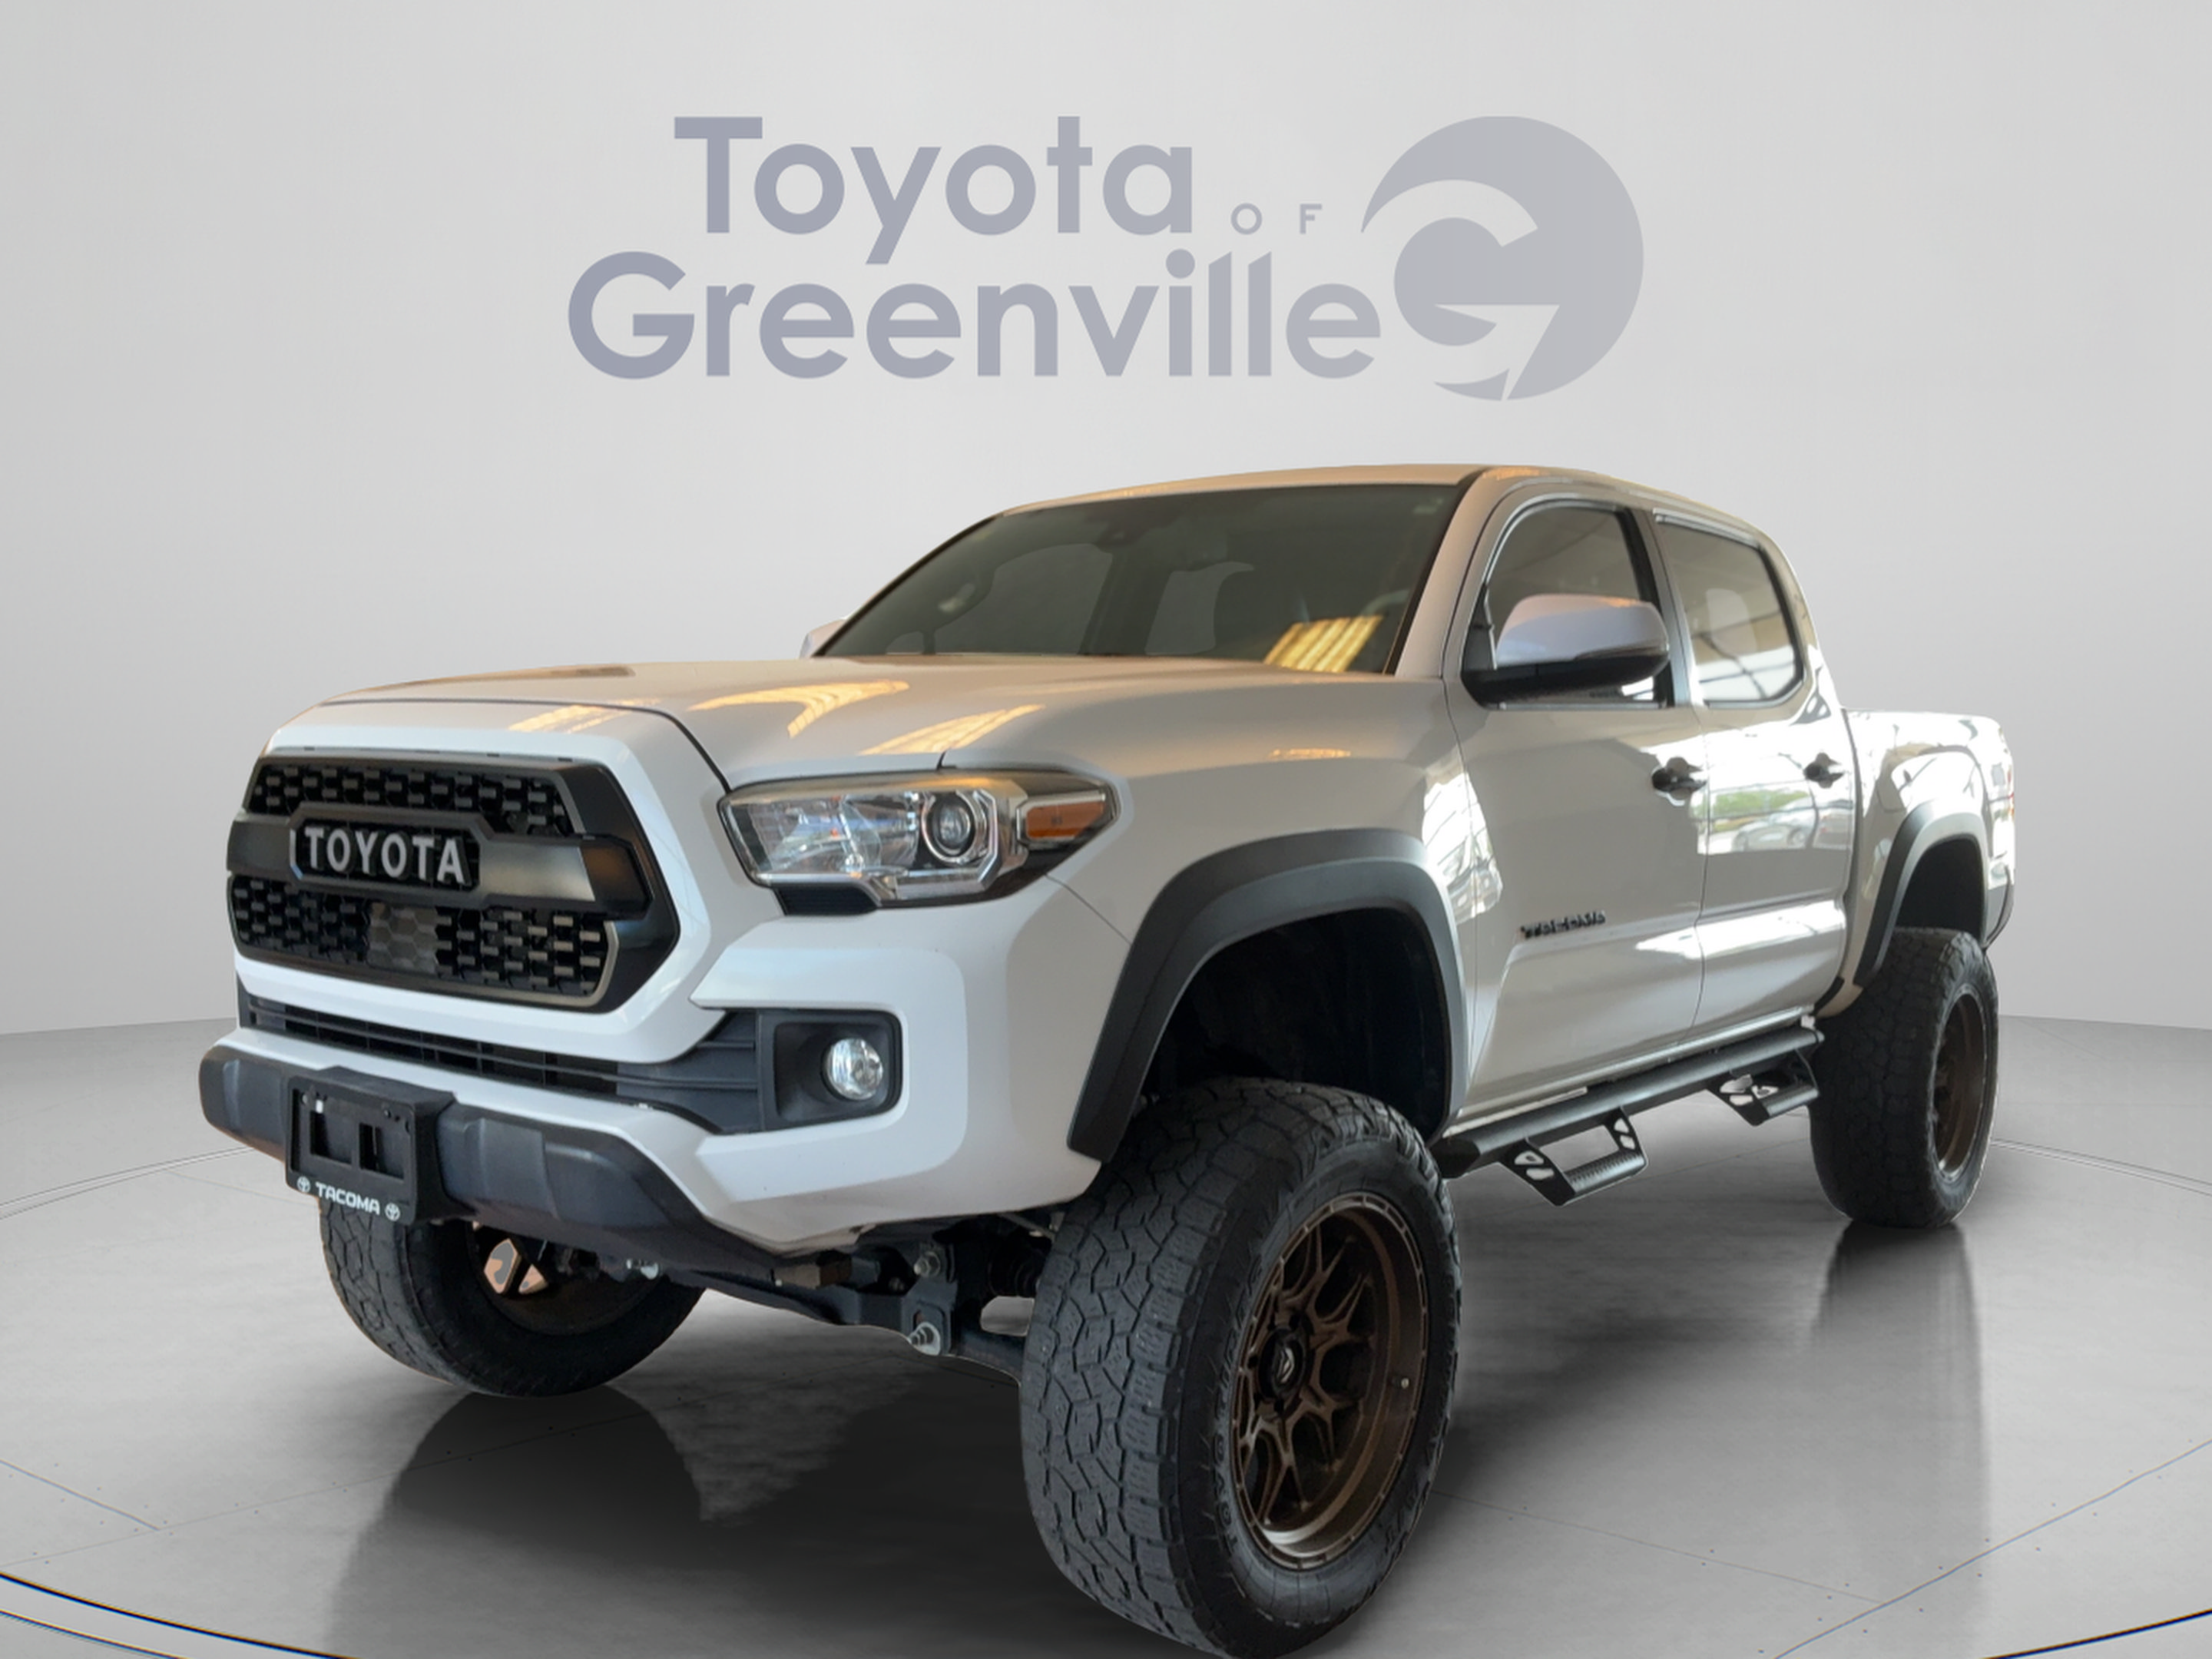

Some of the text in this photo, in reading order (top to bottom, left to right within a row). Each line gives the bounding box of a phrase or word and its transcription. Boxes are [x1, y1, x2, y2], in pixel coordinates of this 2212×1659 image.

[674, 116, 1323, 265] Toyota OF
[568, 249, 1381, 380] Greenville
[304, 825, 465, 885] TOYOTA
[315, 1181, 380, 1215] TACOMA
